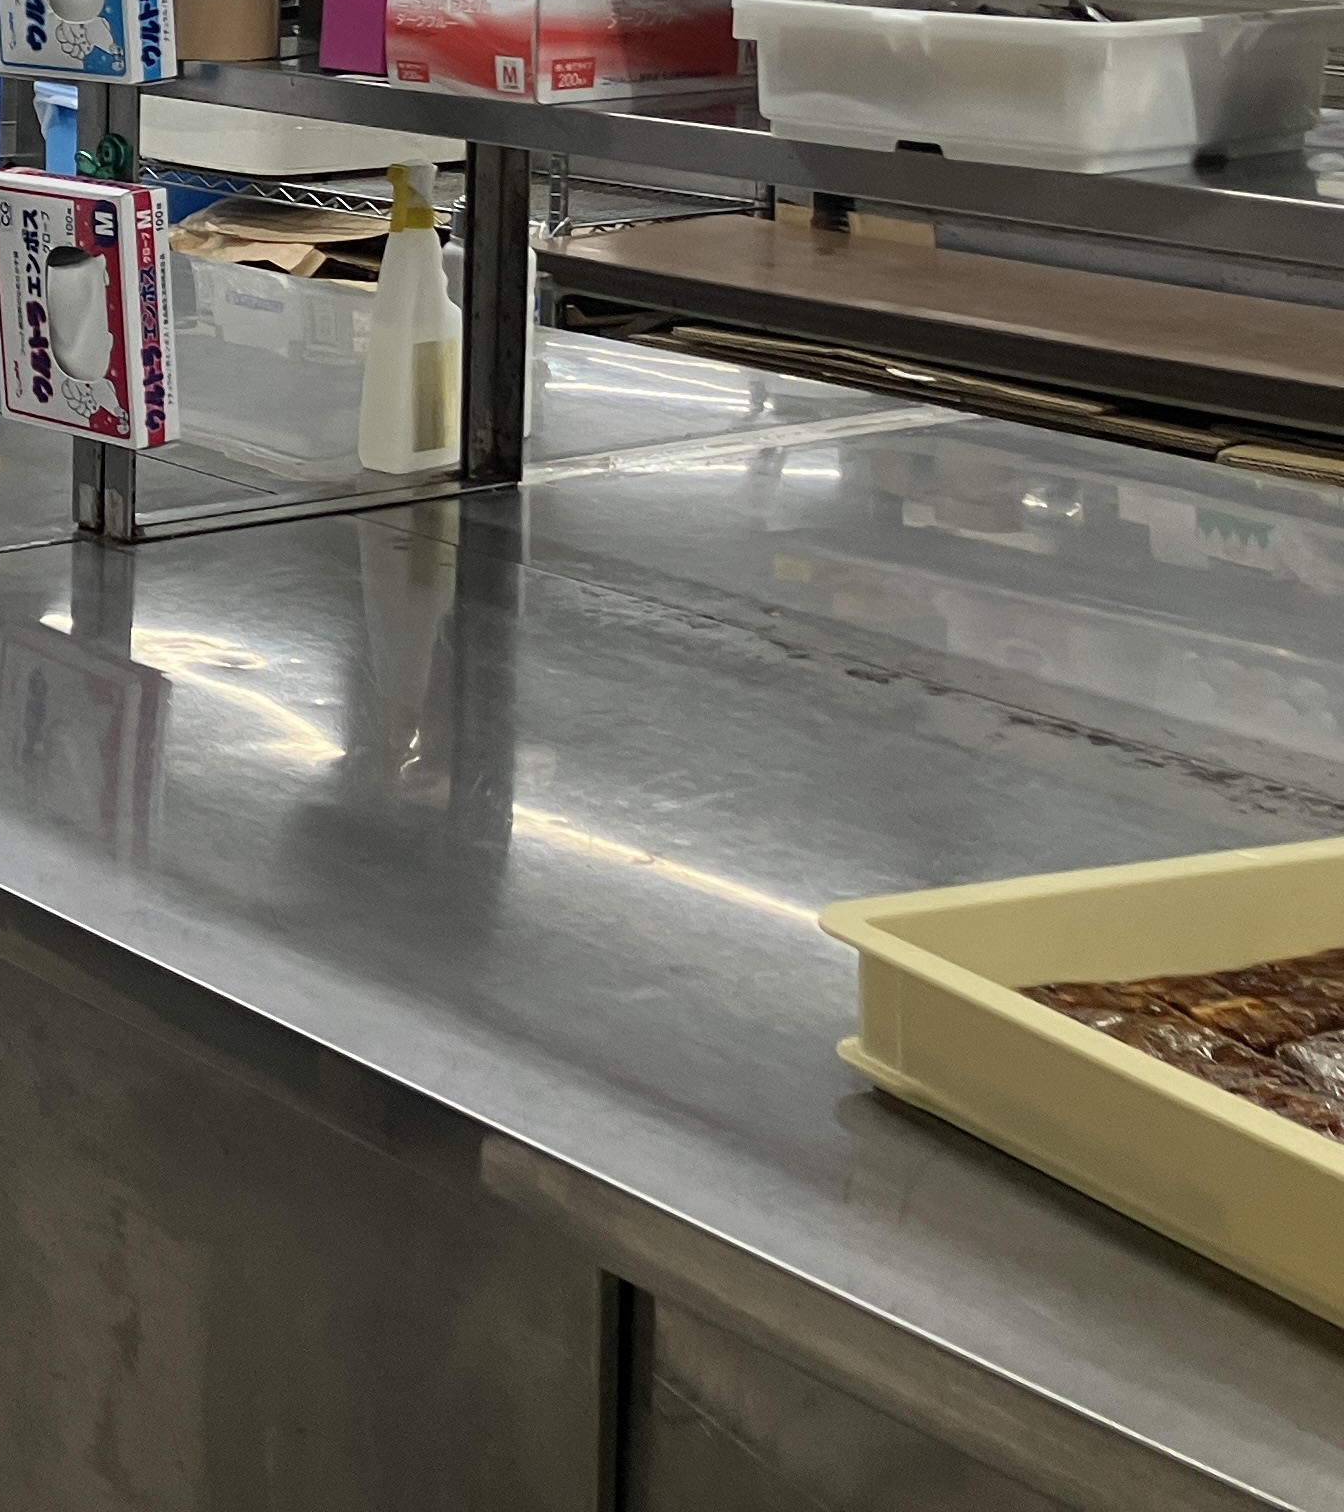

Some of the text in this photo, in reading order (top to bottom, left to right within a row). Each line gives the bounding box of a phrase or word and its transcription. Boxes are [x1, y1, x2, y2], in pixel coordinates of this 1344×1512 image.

[502, 65, 517, 85] M
[93, 211, 115, 238] M
[136, 210, 153, 230] M
